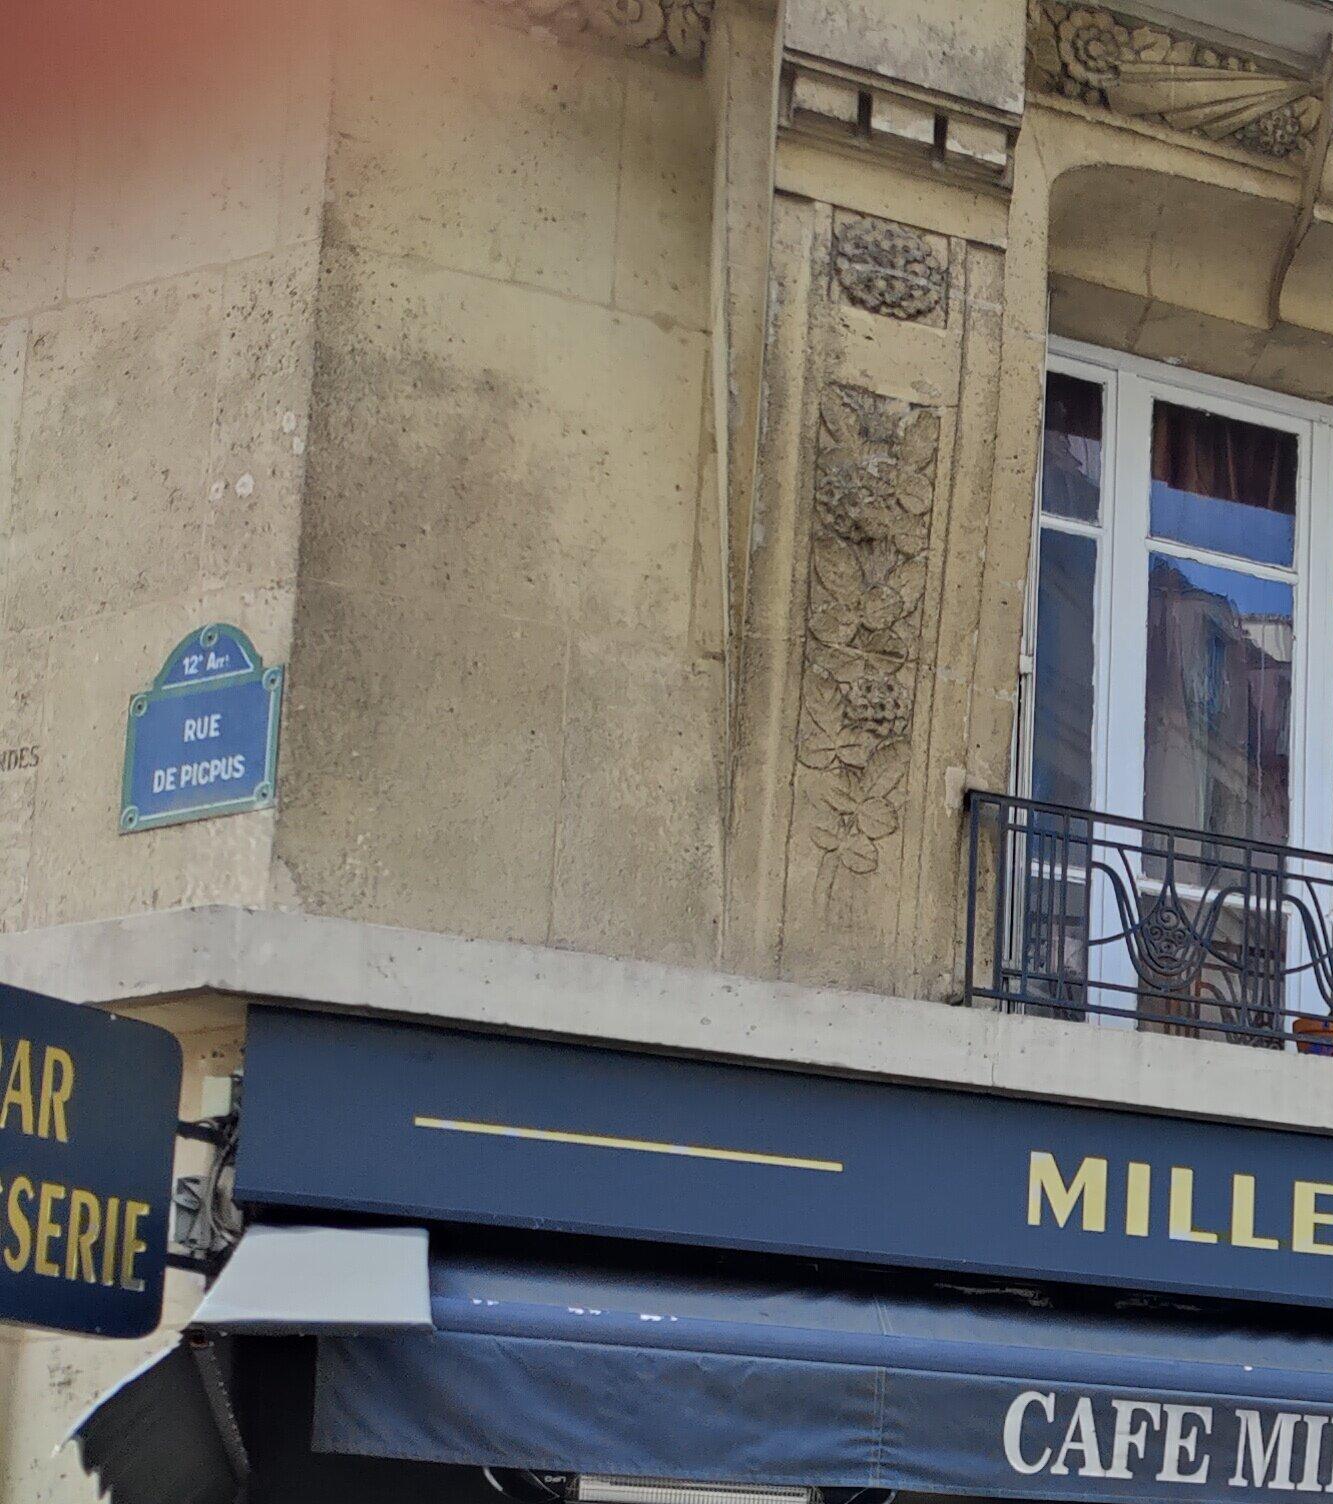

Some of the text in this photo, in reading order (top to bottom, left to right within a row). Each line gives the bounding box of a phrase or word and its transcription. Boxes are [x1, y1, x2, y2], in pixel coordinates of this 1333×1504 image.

[152, 754, 246, 794] DE PICPUS
[183, 713, 223, 743] RUE
[0, 1039, 74, 1143] AR
[0, 1176, 150, 1292] SERIE
[1003, 1389, 1212, 1484] CAFE
